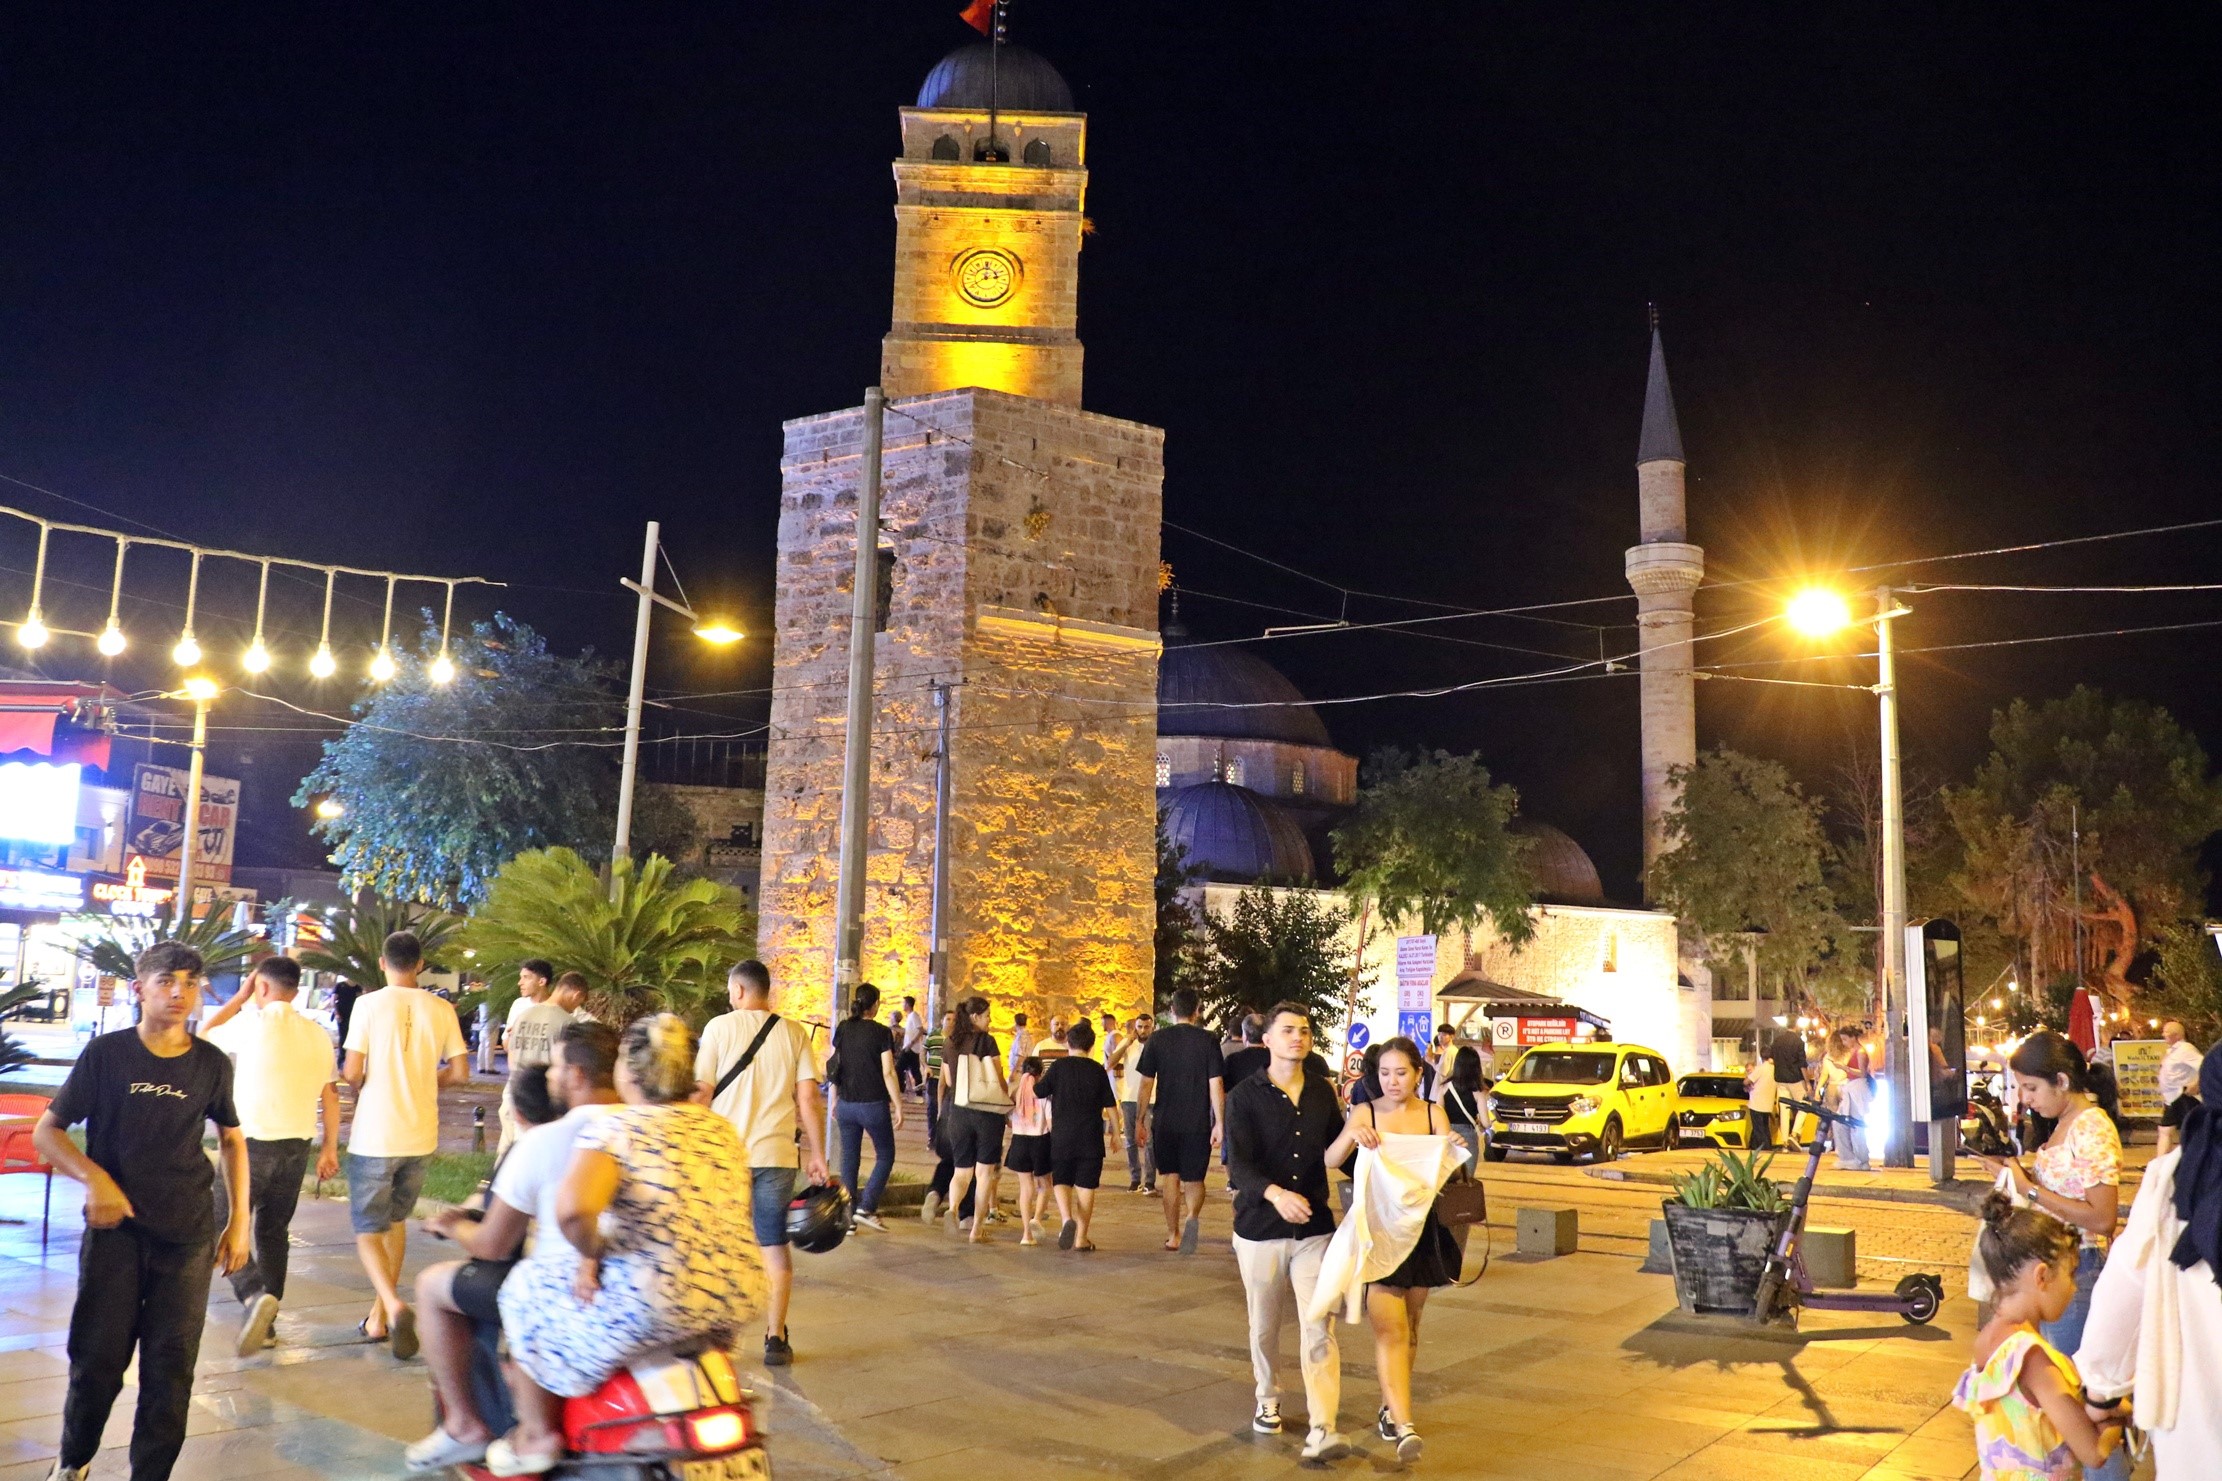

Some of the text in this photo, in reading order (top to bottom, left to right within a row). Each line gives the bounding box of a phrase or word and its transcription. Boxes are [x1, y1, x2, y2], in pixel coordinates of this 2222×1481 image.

[141, 771, 178, 797] GAYE
[198, 803, 231, 829] CAR
[519, 1021, 549, 1036] FIRE
[1350, 1057, 1364, 1070] 20
